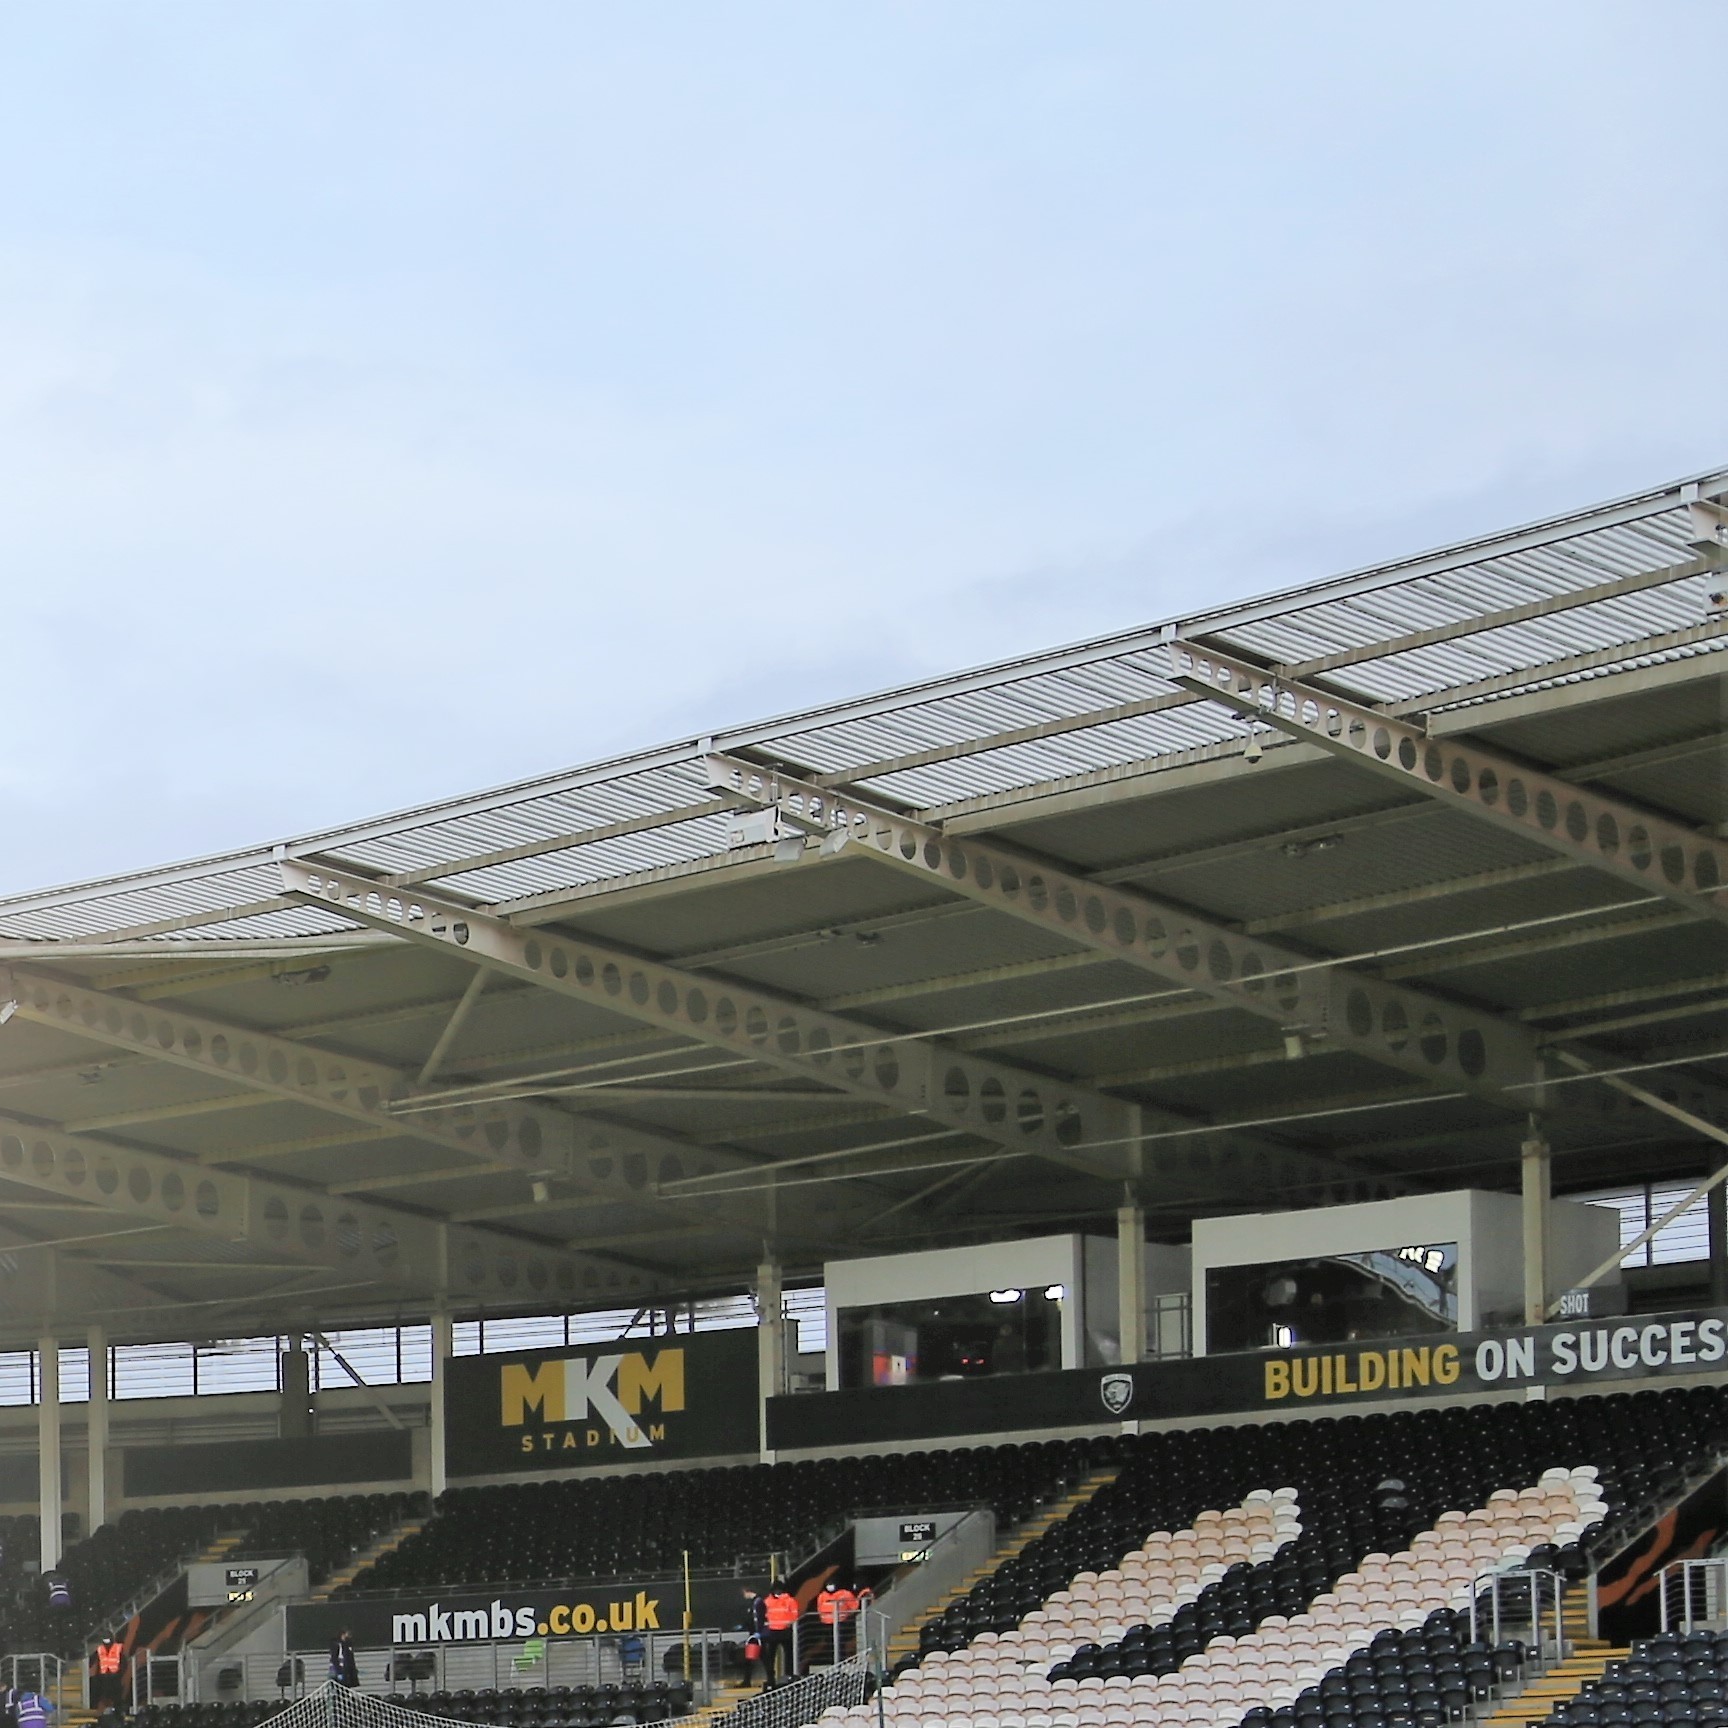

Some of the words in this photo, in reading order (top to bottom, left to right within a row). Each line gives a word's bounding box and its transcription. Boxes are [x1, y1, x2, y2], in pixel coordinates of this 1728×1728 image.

[1560, 1293, 1589, 1315] SHOT
[1264, 1344, 1460, 1400] BUILDING
[1475, 1337, 1535, 1380] ON
[1550, 1318, 1728, 1375] SUCCES
[500, 1348, 685, 1448] MKM
[904, 1524, 930, 1533] BLOCK
[230, 1570, 253, 1578] BLOCK
[392, 1592, 661, 1643] mkmbs.co.uk
